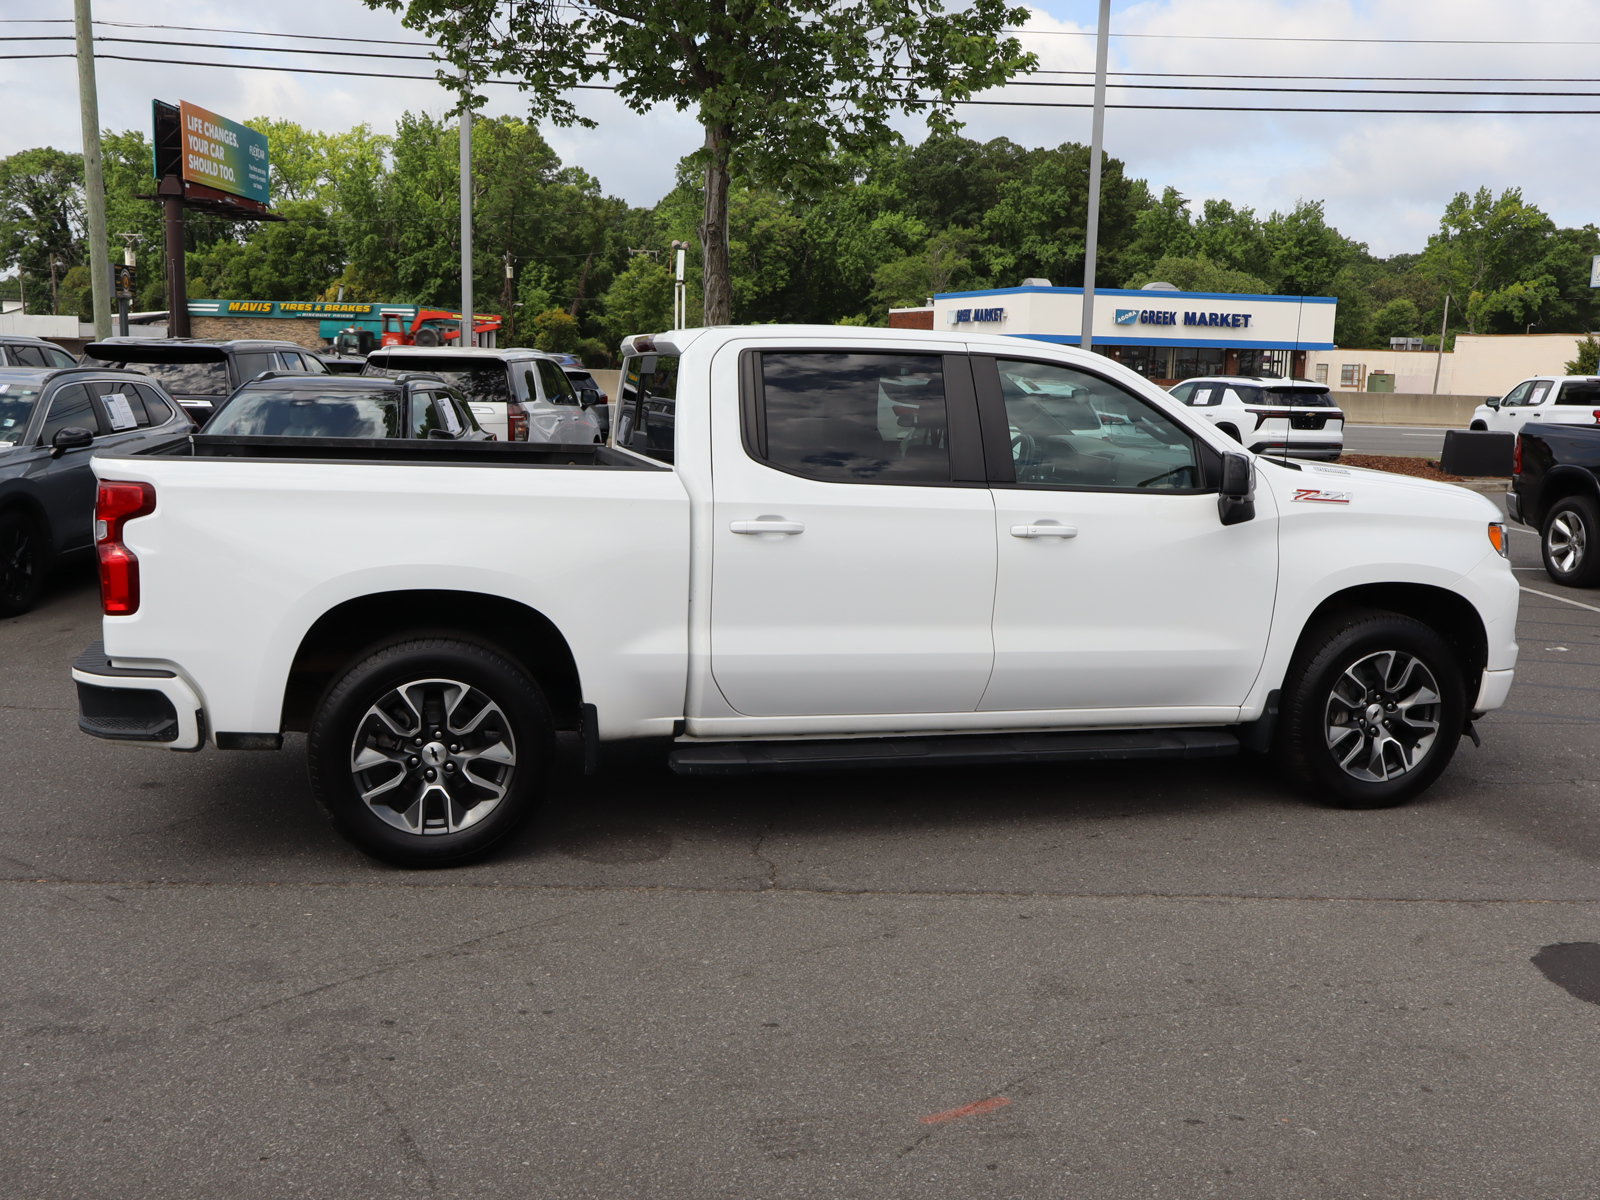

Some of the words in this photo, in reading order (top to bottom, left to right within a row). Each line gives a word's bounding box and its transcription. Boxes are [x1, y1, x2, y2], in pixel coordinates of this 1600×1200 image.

[187, 115, 202, 134] LIFE
[204, 121, 239, 148] CHANGES.
[188, 134, 209, 156] YOUR
[210, 143, 225, 160] CAR
[188, 154, 218, 176] SHOULD
[219, 165, 236, 183] TOO.
[228, 302, 272, 312] MAVIS
[280, 303, 313, 311] TIRES
[324, 304, 371, 312] BRAKES
[973, 308, 1004, 322] MARKET
[1117, 310, 1137, 323] AGORA
[1140, 310, 1177, 326] GREEK
[1184, 311, 1252, 328] MARKET
